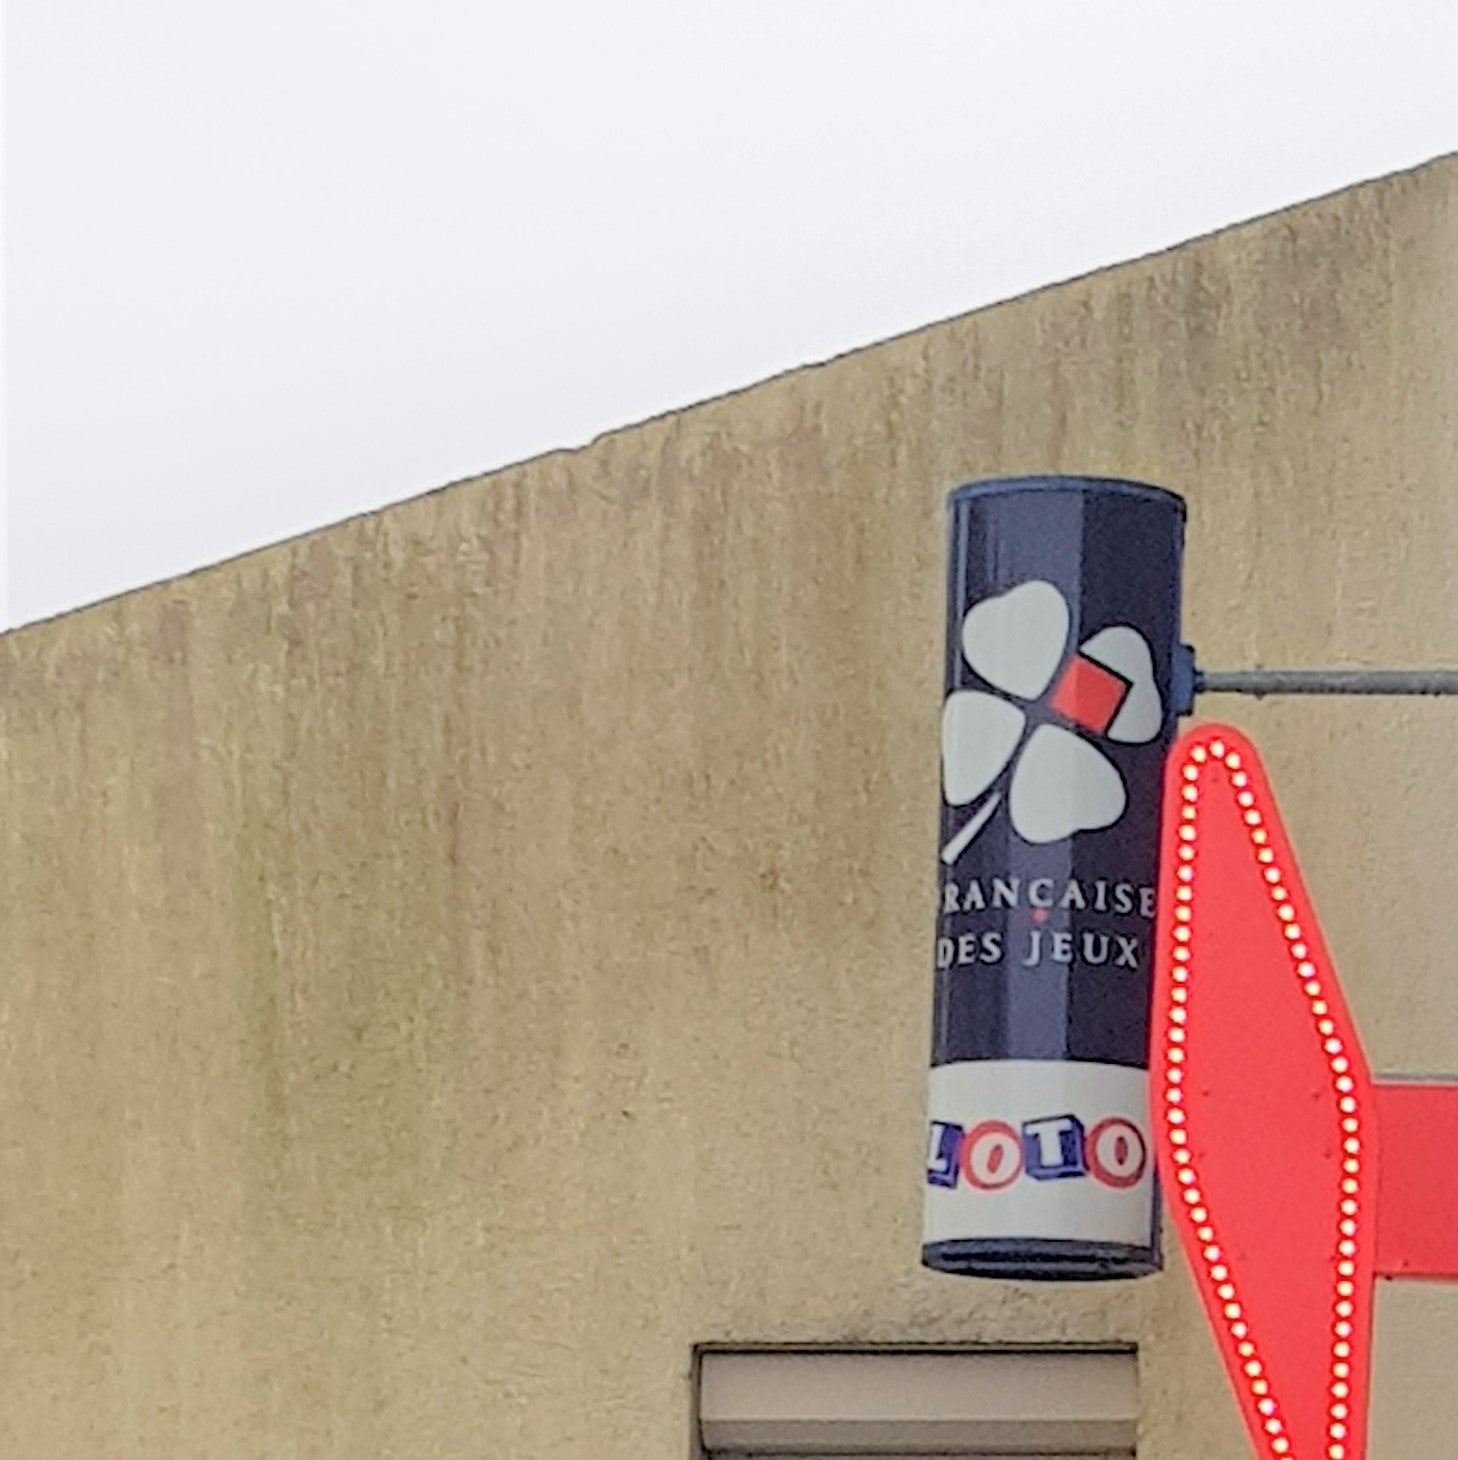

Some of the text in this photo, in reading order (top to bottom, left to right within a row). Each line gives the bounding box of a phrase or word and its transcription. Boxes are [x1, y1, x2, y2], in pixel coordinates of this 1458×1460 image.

[937, 930, 1138, 970] DES JEUX
[927, 1115, 1147, 1190] LOTO
